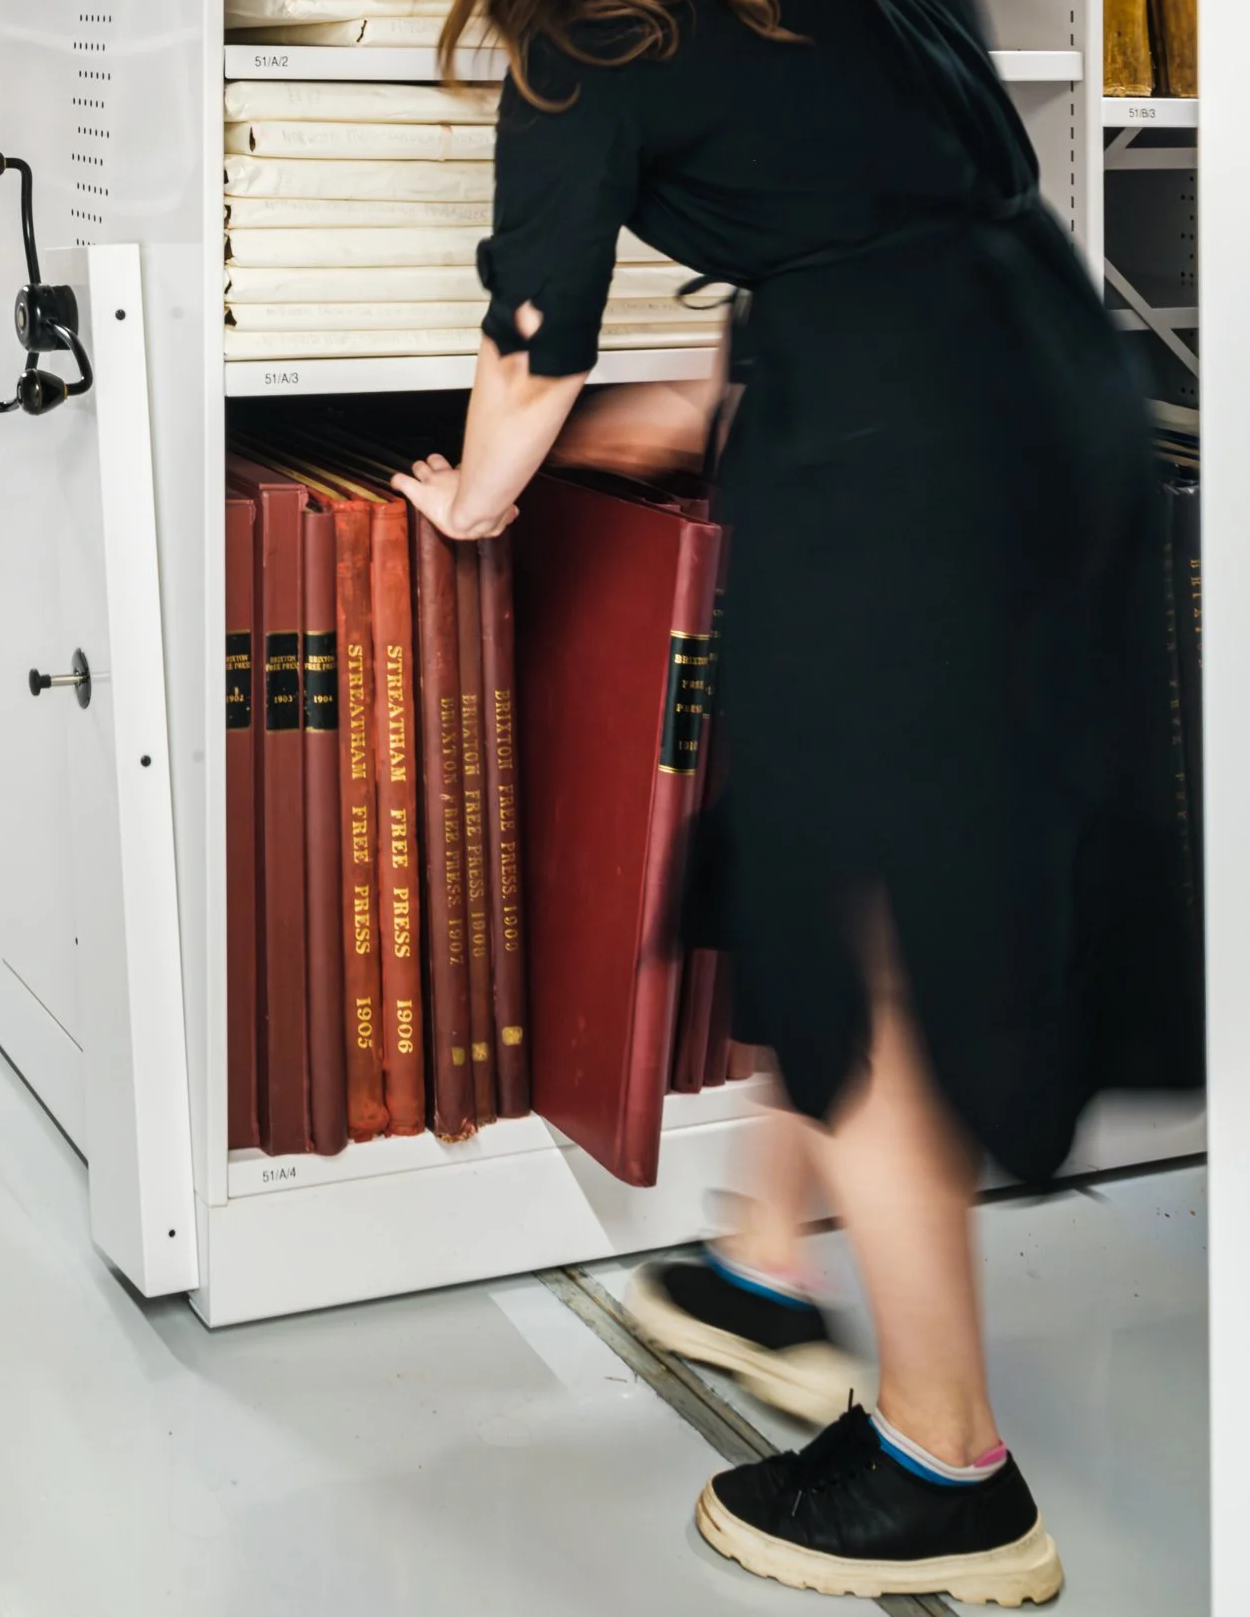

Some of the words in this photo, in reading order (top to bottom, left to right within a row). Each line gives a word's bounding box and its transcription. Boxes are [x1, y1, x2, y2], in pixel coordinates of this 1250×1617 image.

[254, 55, 289, 68] 51/A/2
[264, 371, 299, 385] 51/A/3
[274, 695, 293, 704] 1903
[313, 694, 334, 703] 1904
[347, 644, 368, 780] STREATHAM
[387, 644, 407, 783] STREATHAM
[462, 694, 480, 775] BRIXTON
[494, 689, 513, 770] BRIXTON
[351, 806, 369, 864] FREE
[465, 789, 482, 837] FREE
[498, 783, 515, 831] FREE
[390, 808, 409, 869] FREE
[354, 884, 371, 956] PRESS
[393, 886, 411, 958] PRESS
[356, 996, 373, 1050] 1905
[396, 998, 414, 1055] 1906
[262, 1166, 297, 1183] 51/A/4
